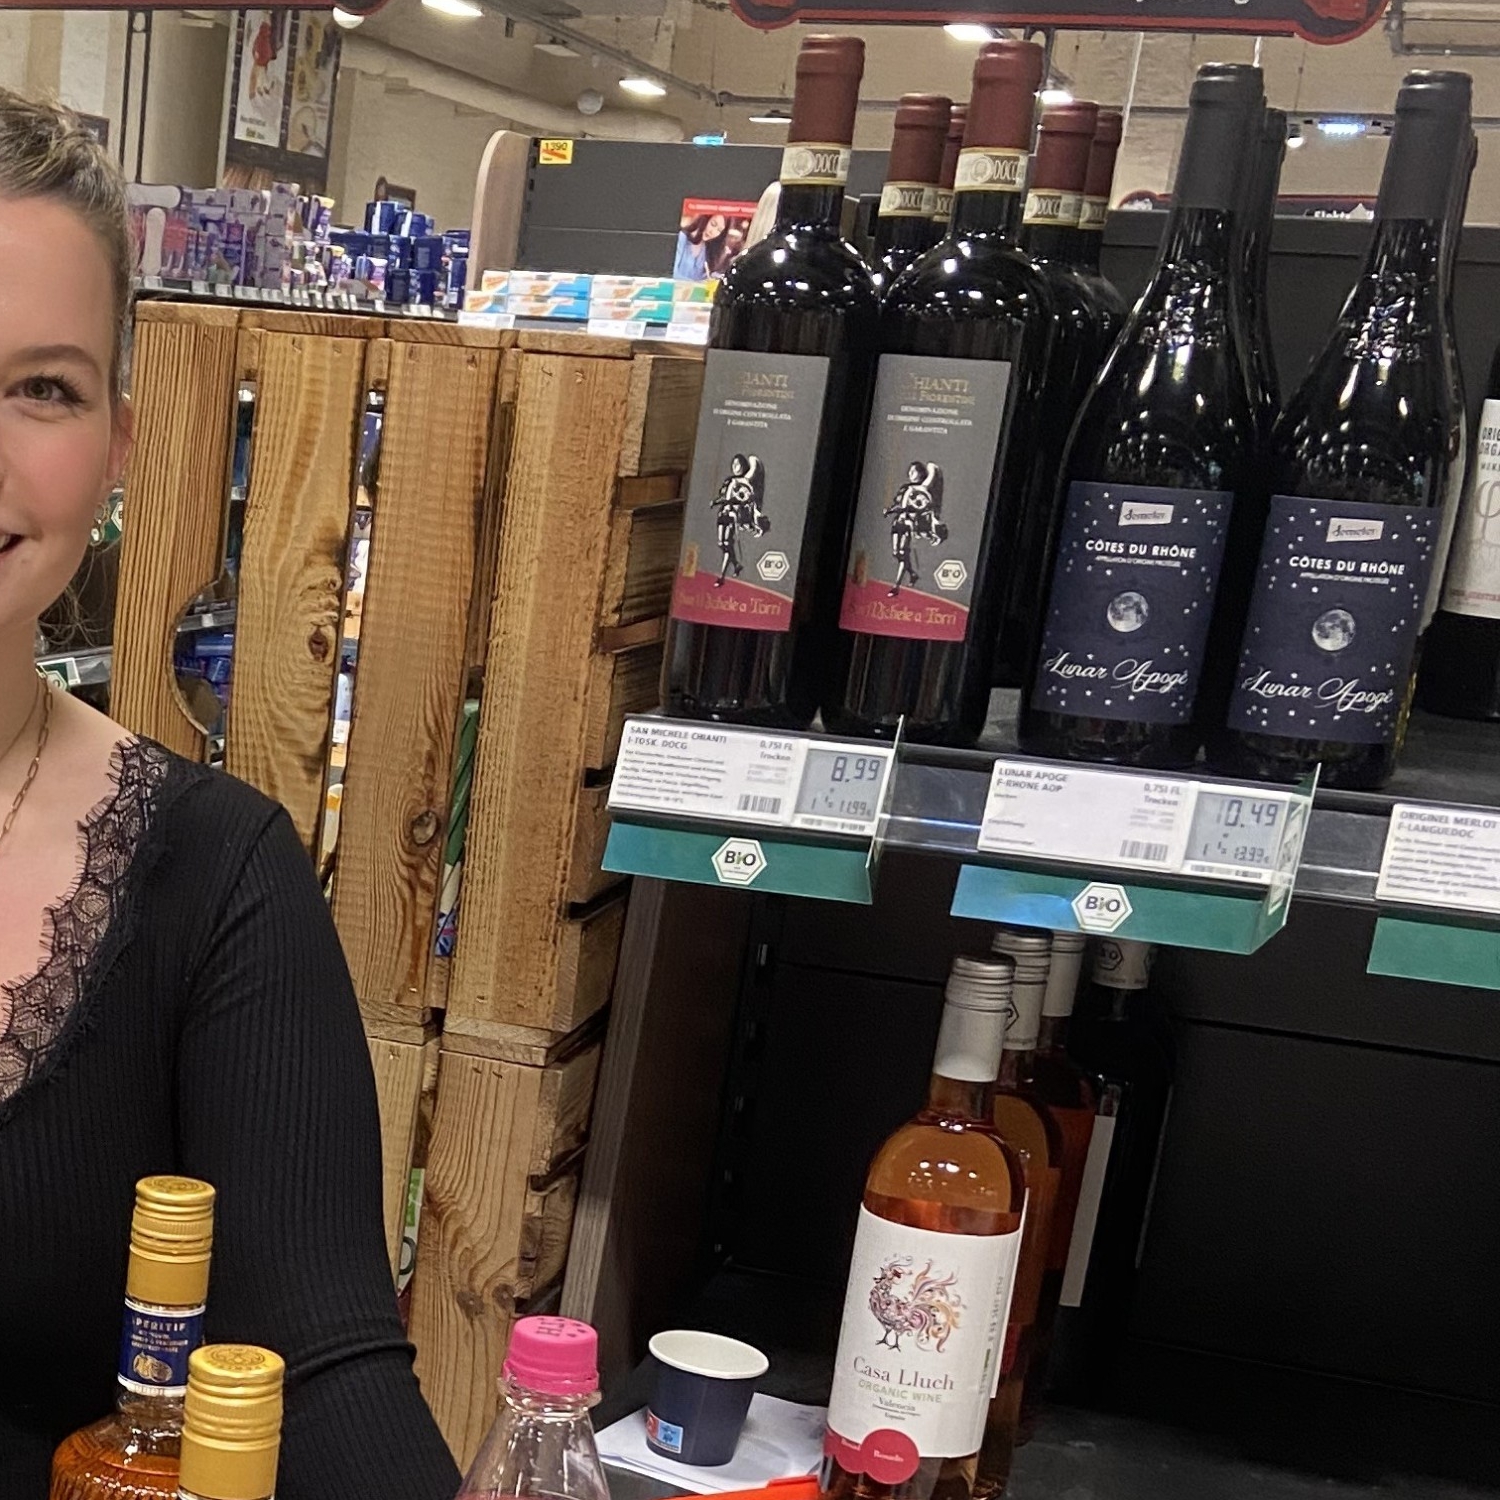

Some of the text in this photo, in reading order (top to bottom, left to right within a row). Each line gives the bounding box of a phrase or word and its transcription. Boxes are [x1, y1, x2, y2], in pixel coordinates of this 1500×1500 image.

[1085, 538, 1196, 559] CÔTES DU RHÔNE
[1290, 554, 1405, 576] CÔTES DU RHÔNE
[630, 725, 649, 736] SAN
[691, 732, 727, 744] CHIANTI
[661, 740, 688, 750] DOCG
[831, 756, 881, 783] 8.99
[999, 768, 1069, 783] LUNAR APOGE
[1042, 783, 1063, 793] AOP
[1401, 810, 1497, 829] ORIGINEL MERLOT
[1397, 822, 1475, 839] F-LANGUEDOC
[853, 1356, 955, 1391] Casa Lluch
[858, 1378, 944, 1404] ORGANIC WINE
